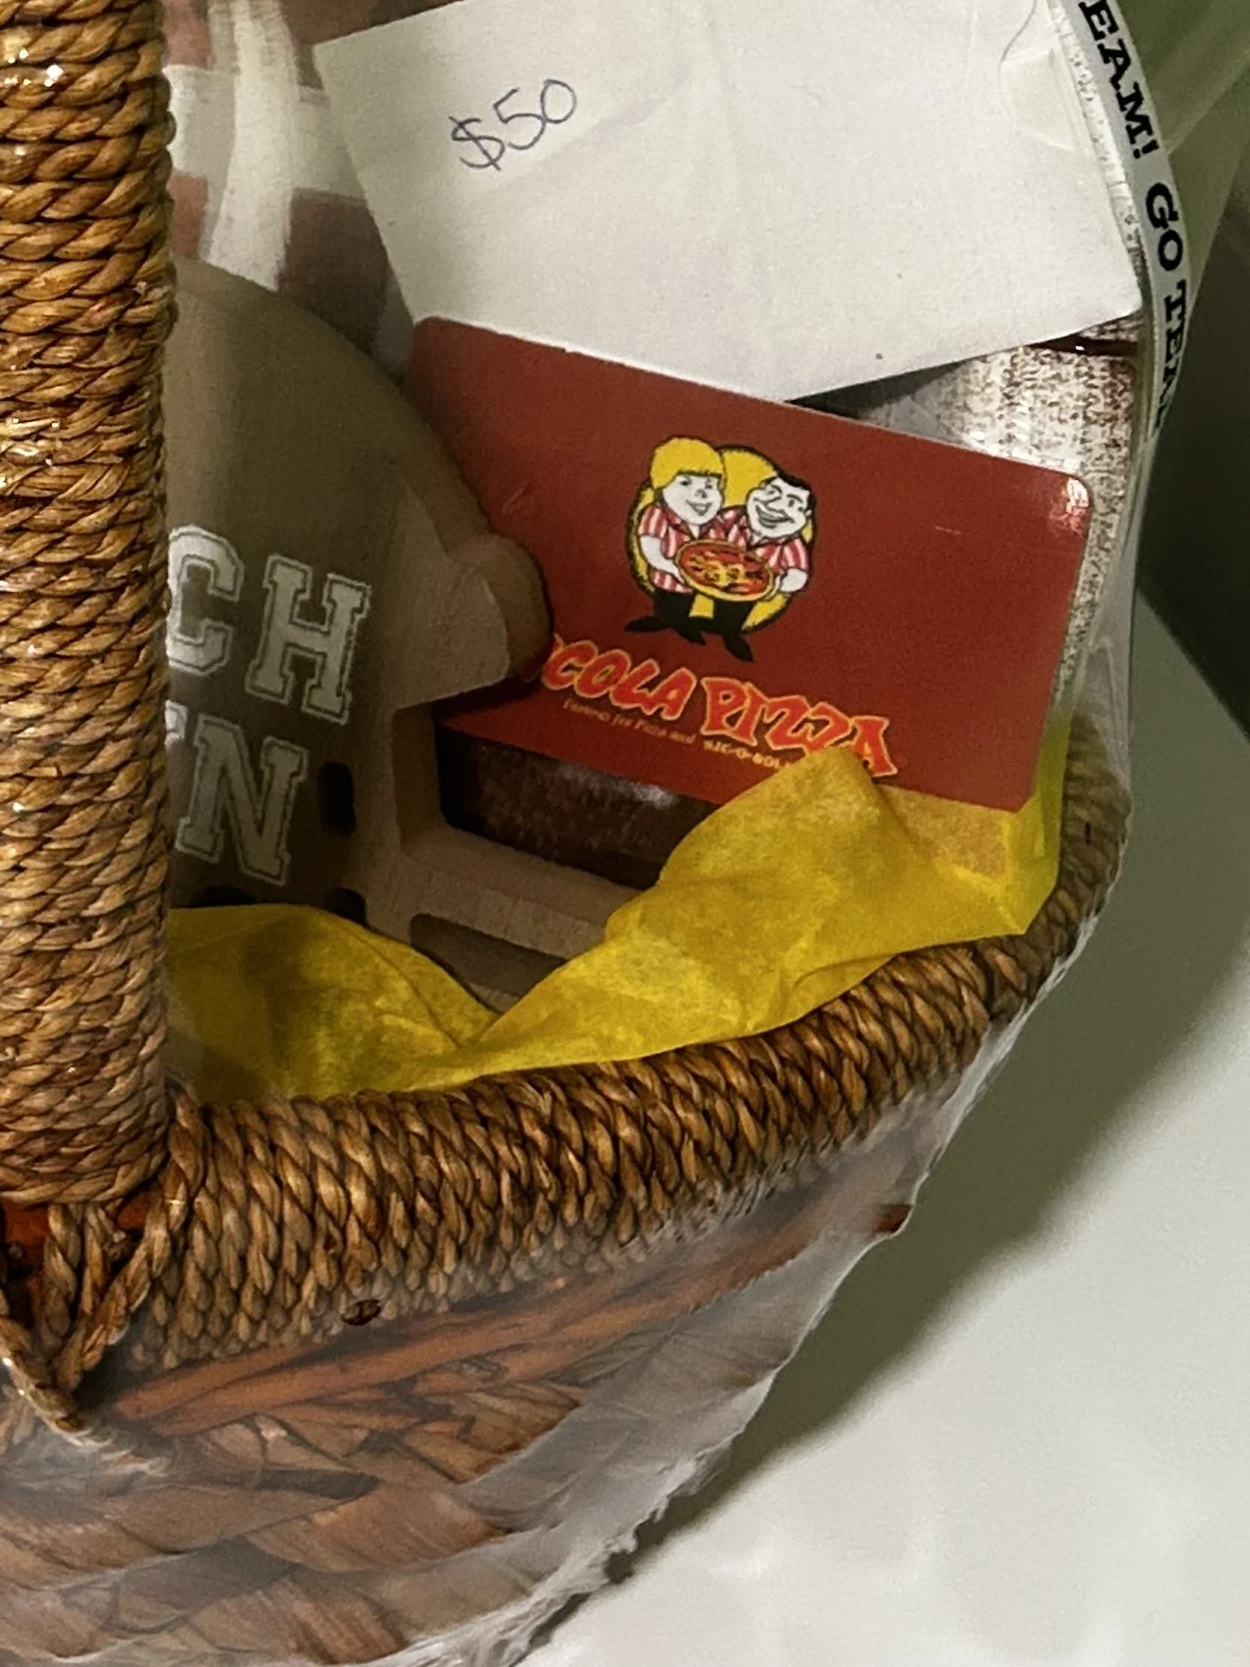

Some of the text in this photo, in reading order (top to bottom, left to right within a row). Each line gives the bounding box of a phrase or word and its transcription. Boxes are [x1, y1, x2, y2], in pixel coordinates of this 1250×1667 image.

[449, 78, 578, 171] $50
[1145, 182, 1184, 272] GO
[542, 635, 899, 779] COLA PIZZA
